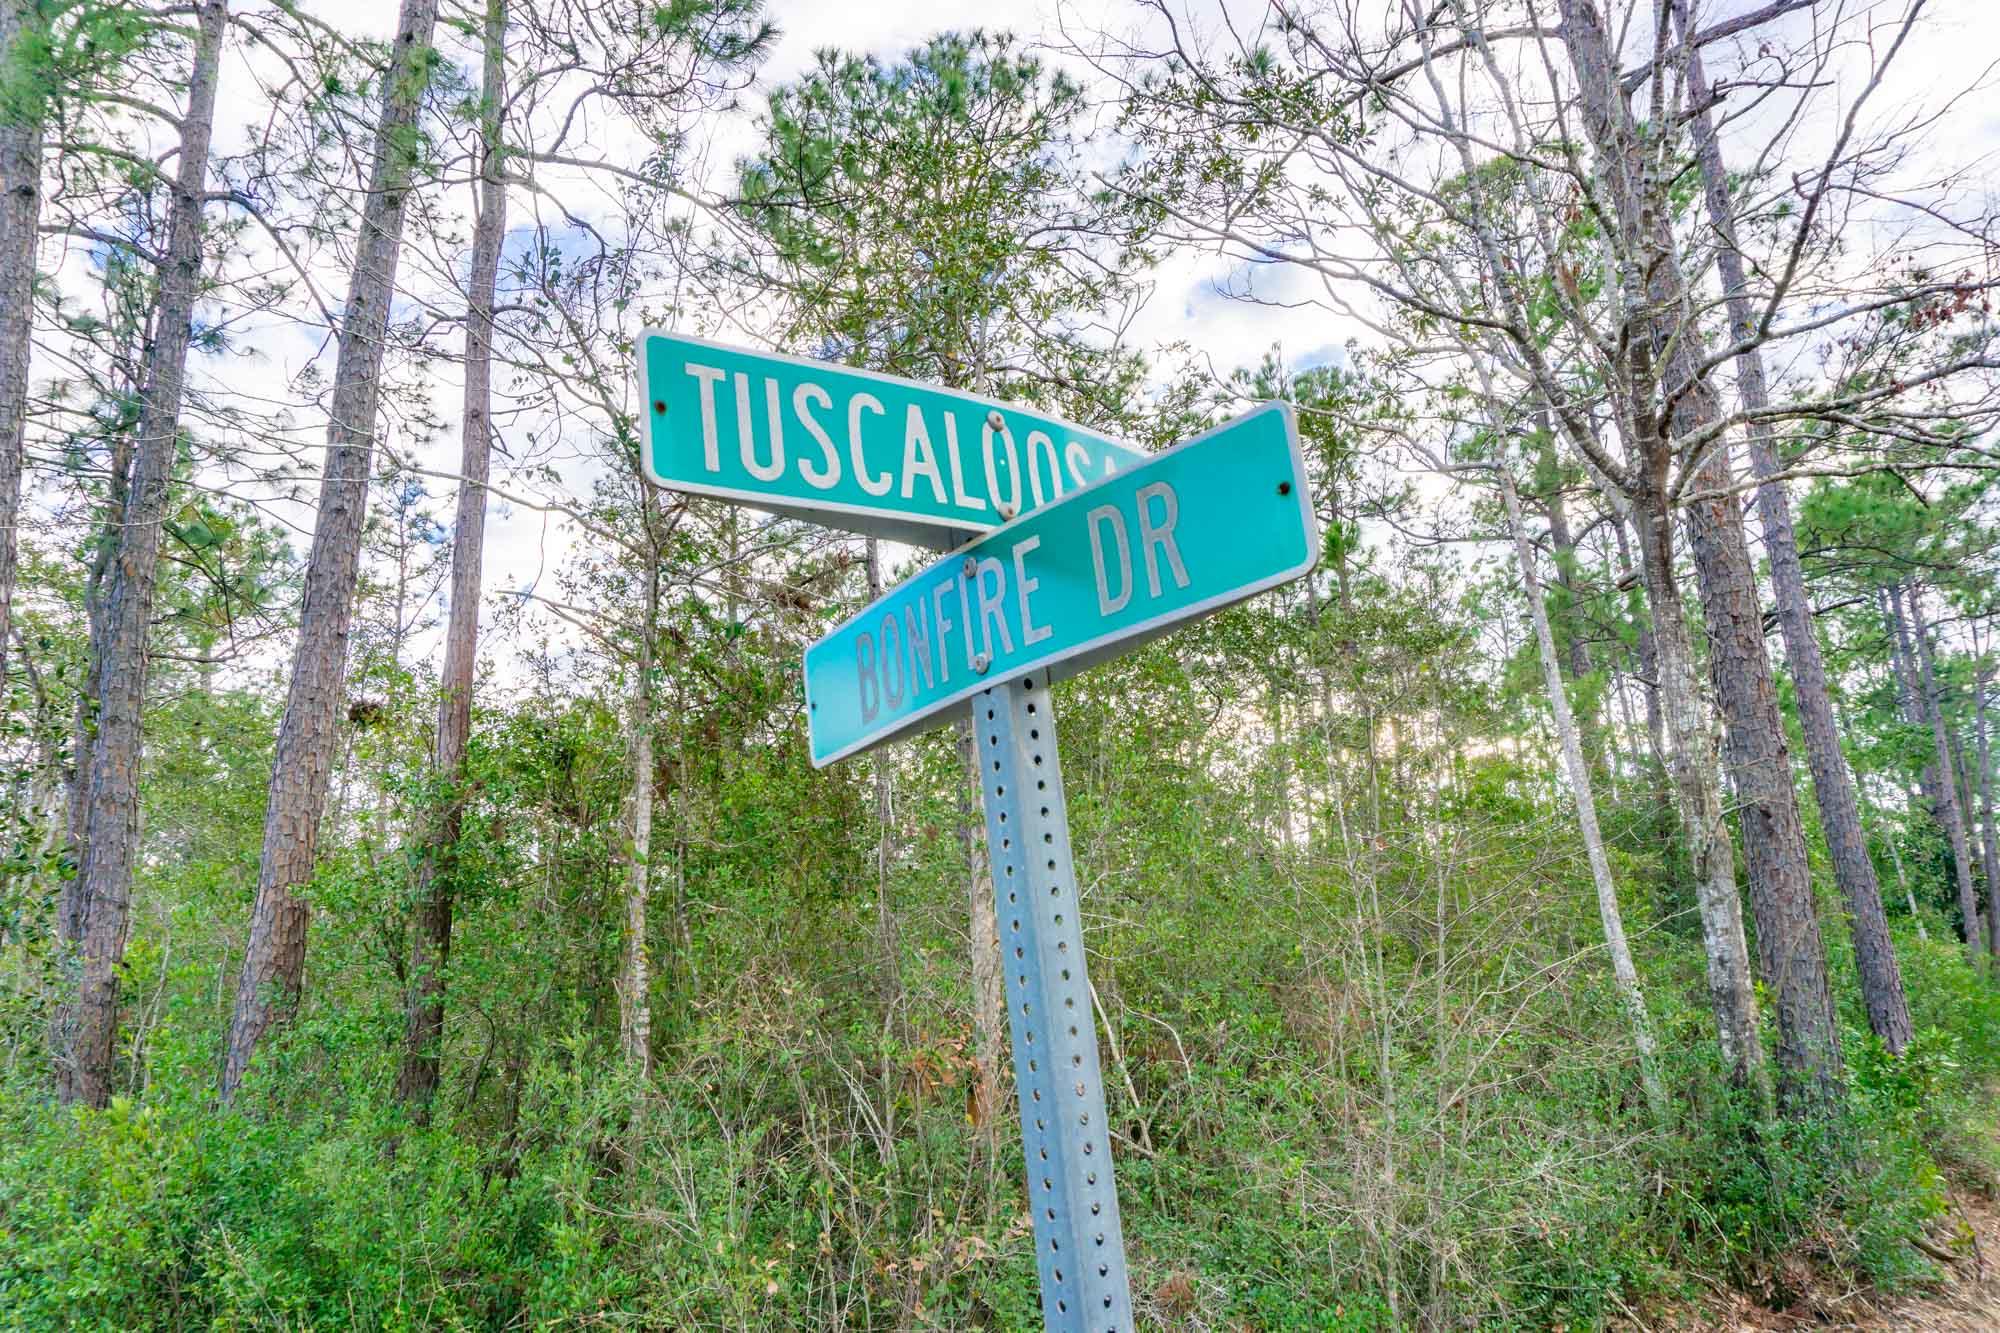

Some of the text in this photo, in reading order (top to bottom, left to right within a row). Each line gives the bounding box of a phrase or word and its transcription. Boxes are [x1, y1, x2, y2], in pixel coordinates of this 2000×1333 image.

[685, 362, 1117, 518] TUSCALOOS
[856, 481, 1190, 725] BONFIRE DR
